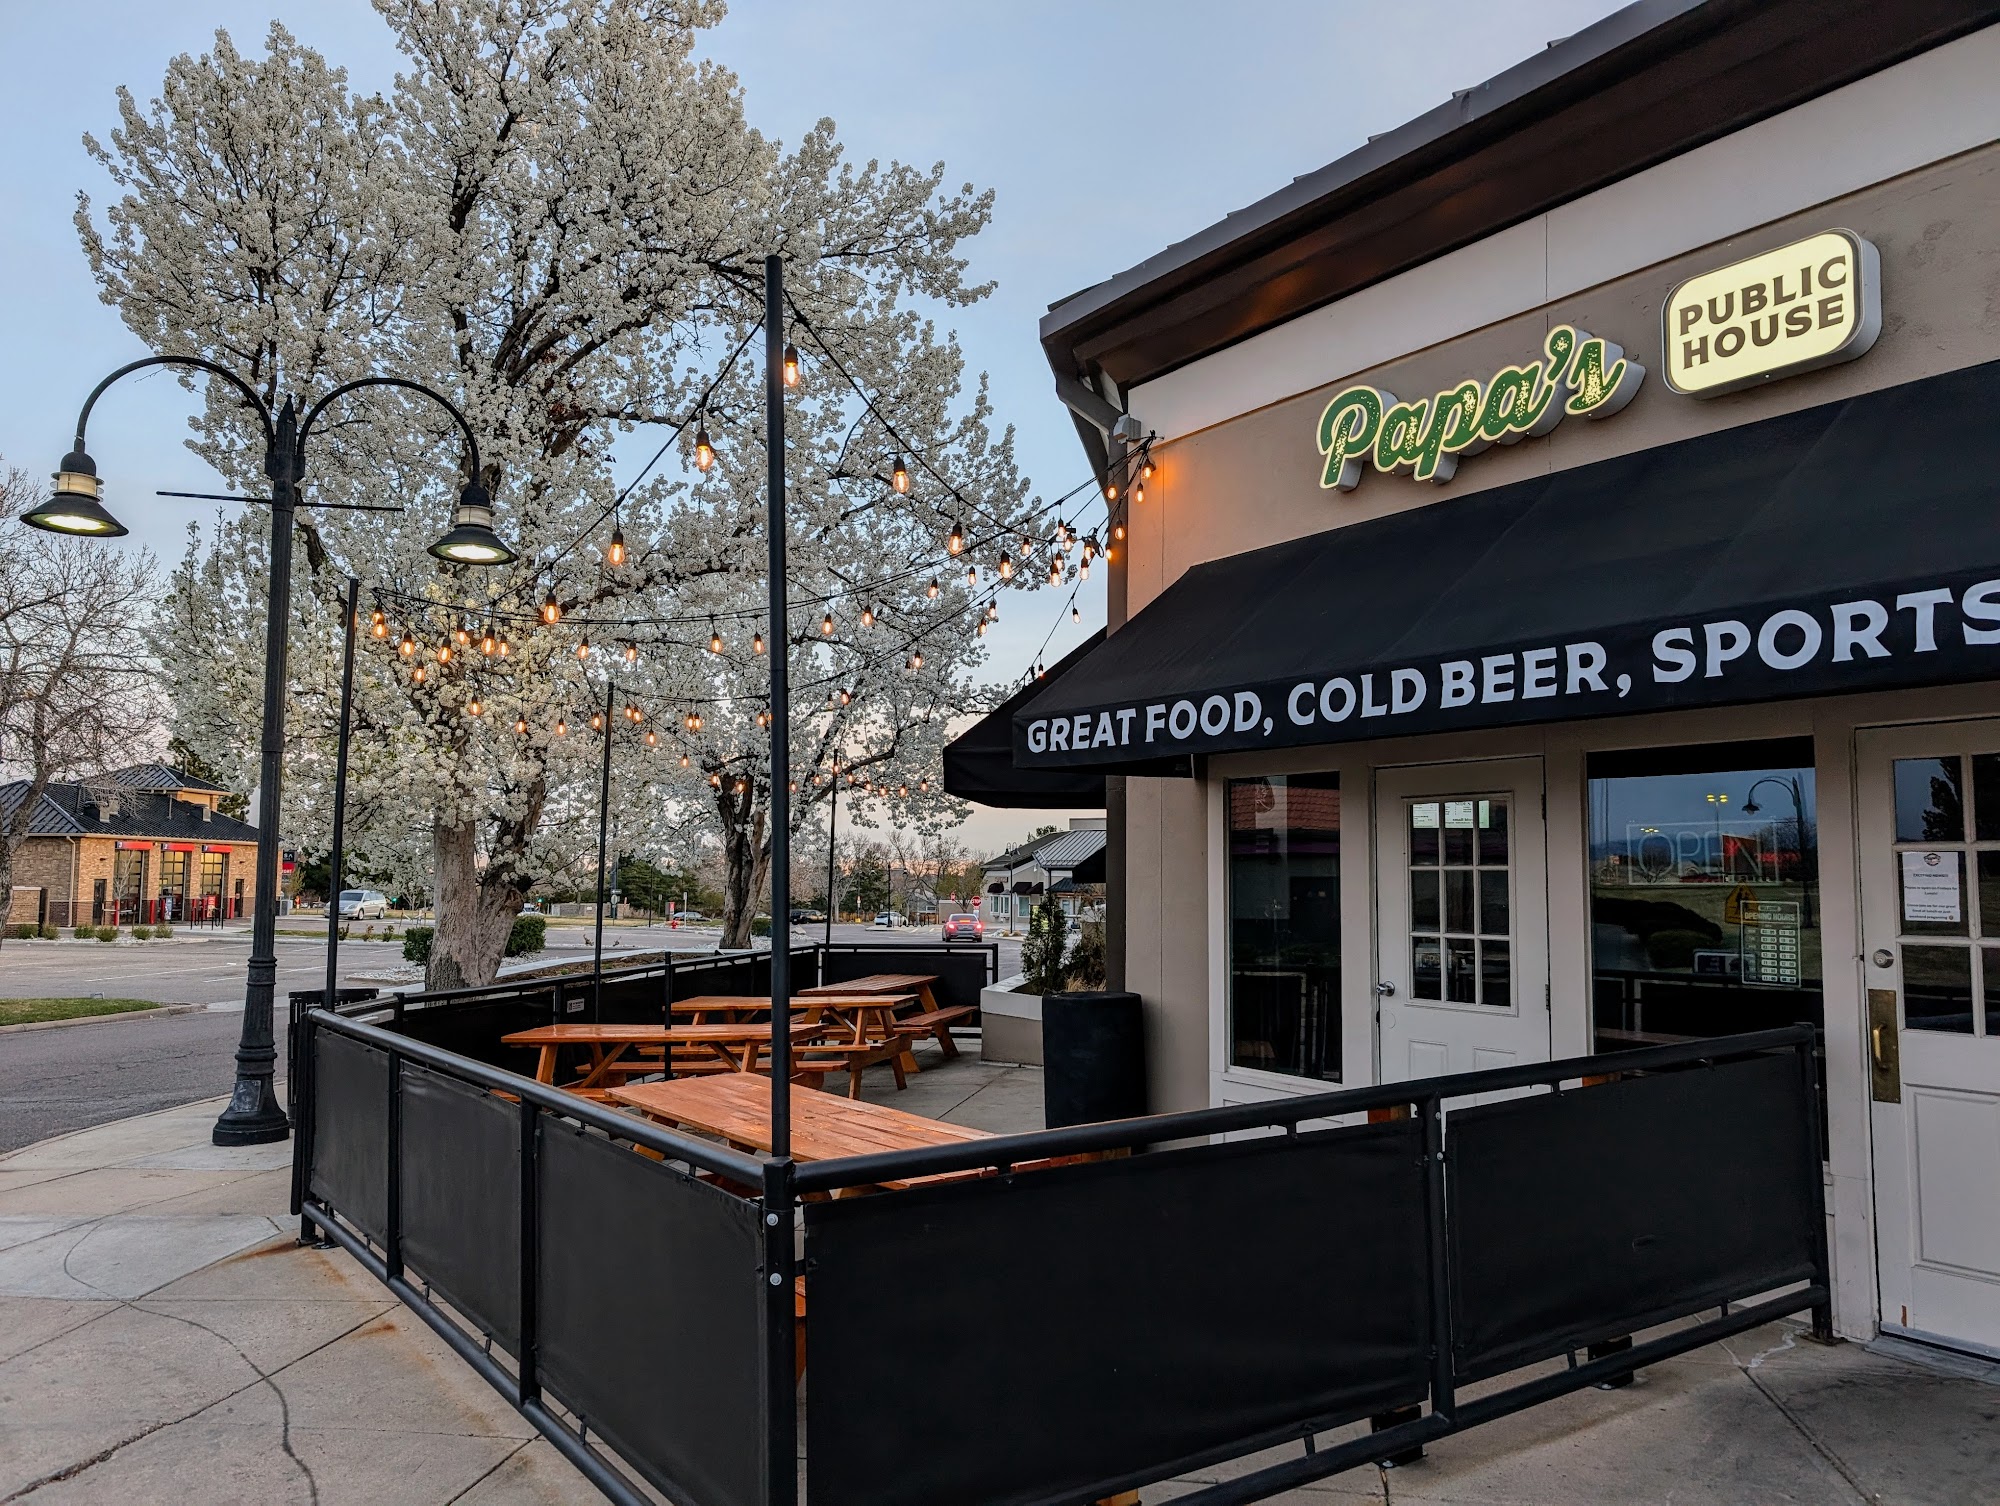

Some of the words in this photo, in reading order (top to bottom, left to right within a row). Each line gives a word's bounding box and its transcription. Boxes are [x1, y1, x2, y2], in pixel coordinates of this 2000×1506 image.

[1678, 254, 1847, 337] PUBLIC
[1682, 292, 1844, 370] HOUSE
[1316, 325, 1626, 491] Papa's
[1027, 708, 1136, 753] GREAT
[1145, 691, 1274, 737] FOOD,
[1287, 667, 1427, 725] COLD
[1440, 641, 1632, 709] BEER,
[1652, 579, 2000, 683] SPORTS
[1638, 830, 1763, 883] OPEN
[1744, 912, 1771, 920] OPENING
[1773, 913, 1795, 921] HOURS
